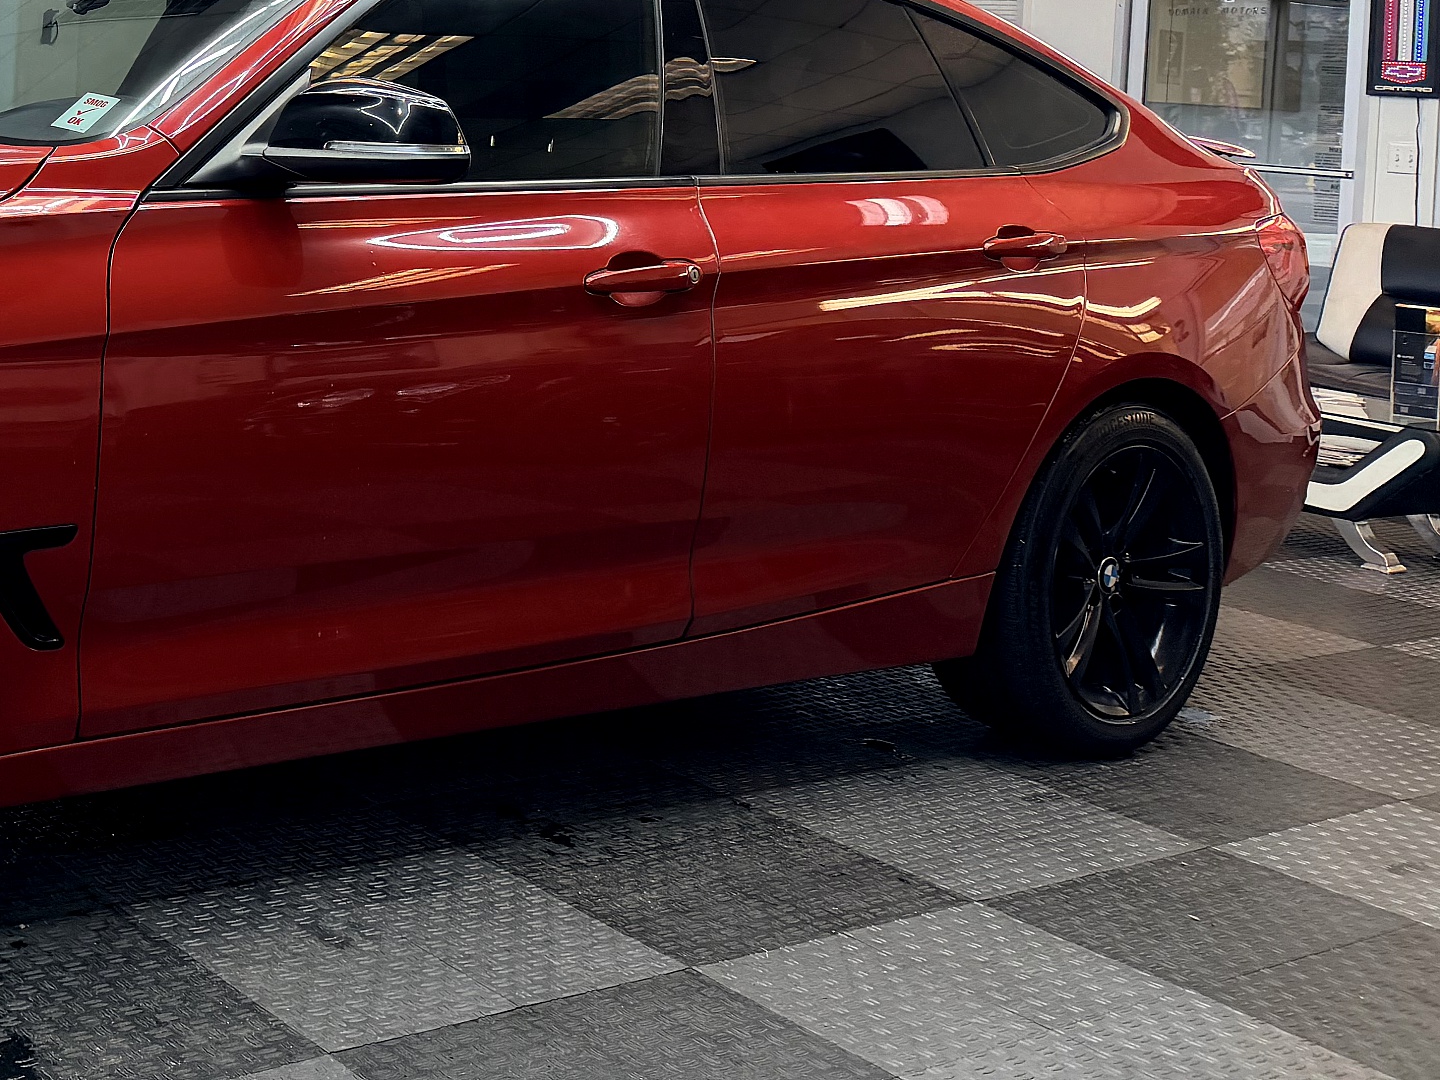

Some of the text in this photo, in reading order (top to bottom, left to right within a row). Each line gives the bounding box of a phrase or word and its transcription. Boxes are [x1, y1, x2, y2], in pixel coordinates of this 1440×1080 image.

[1221, 6, 1268, 16] MOTORS
[1374, 85, 1433, 93] CAMARO
[83, 98, 109, 108] SMOG
[67, 116, 85, 126] OK
